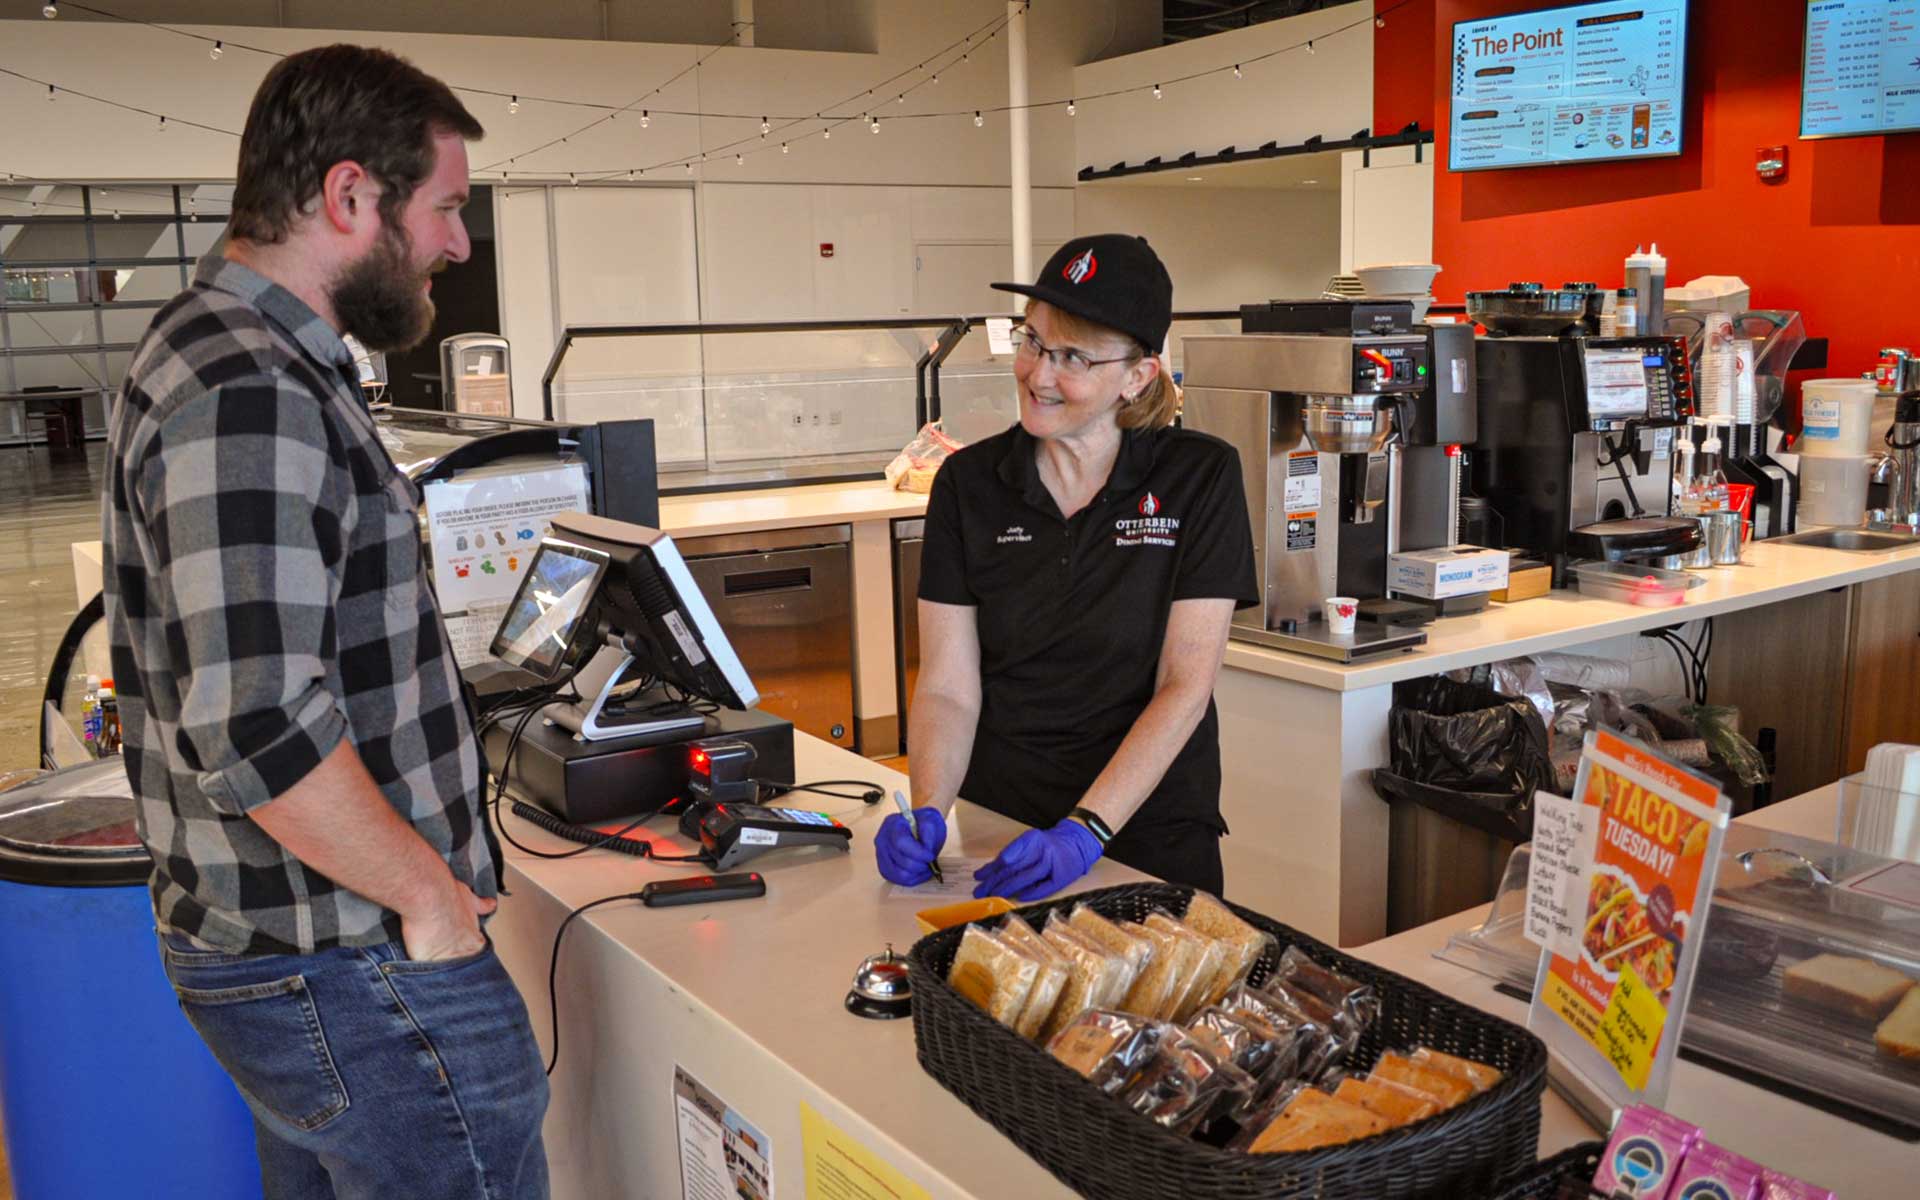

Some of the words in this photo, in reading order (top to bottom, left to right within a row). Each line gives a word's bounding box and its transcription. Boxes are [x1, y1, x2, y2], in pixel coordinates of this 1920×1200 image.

[1472, 36, 1508, 57] The
[1512, 27, 1564, 52] Point
[1381, 348, 1405, 357] BUNN
[1115, 517, 1180, 530] OTTERBEIN
[1439, 570, 1473, 584] MONOGRAM
[1613, 775, 1679, 845] TACO
[1604, 817, 1676, 878] TUESDAY!
